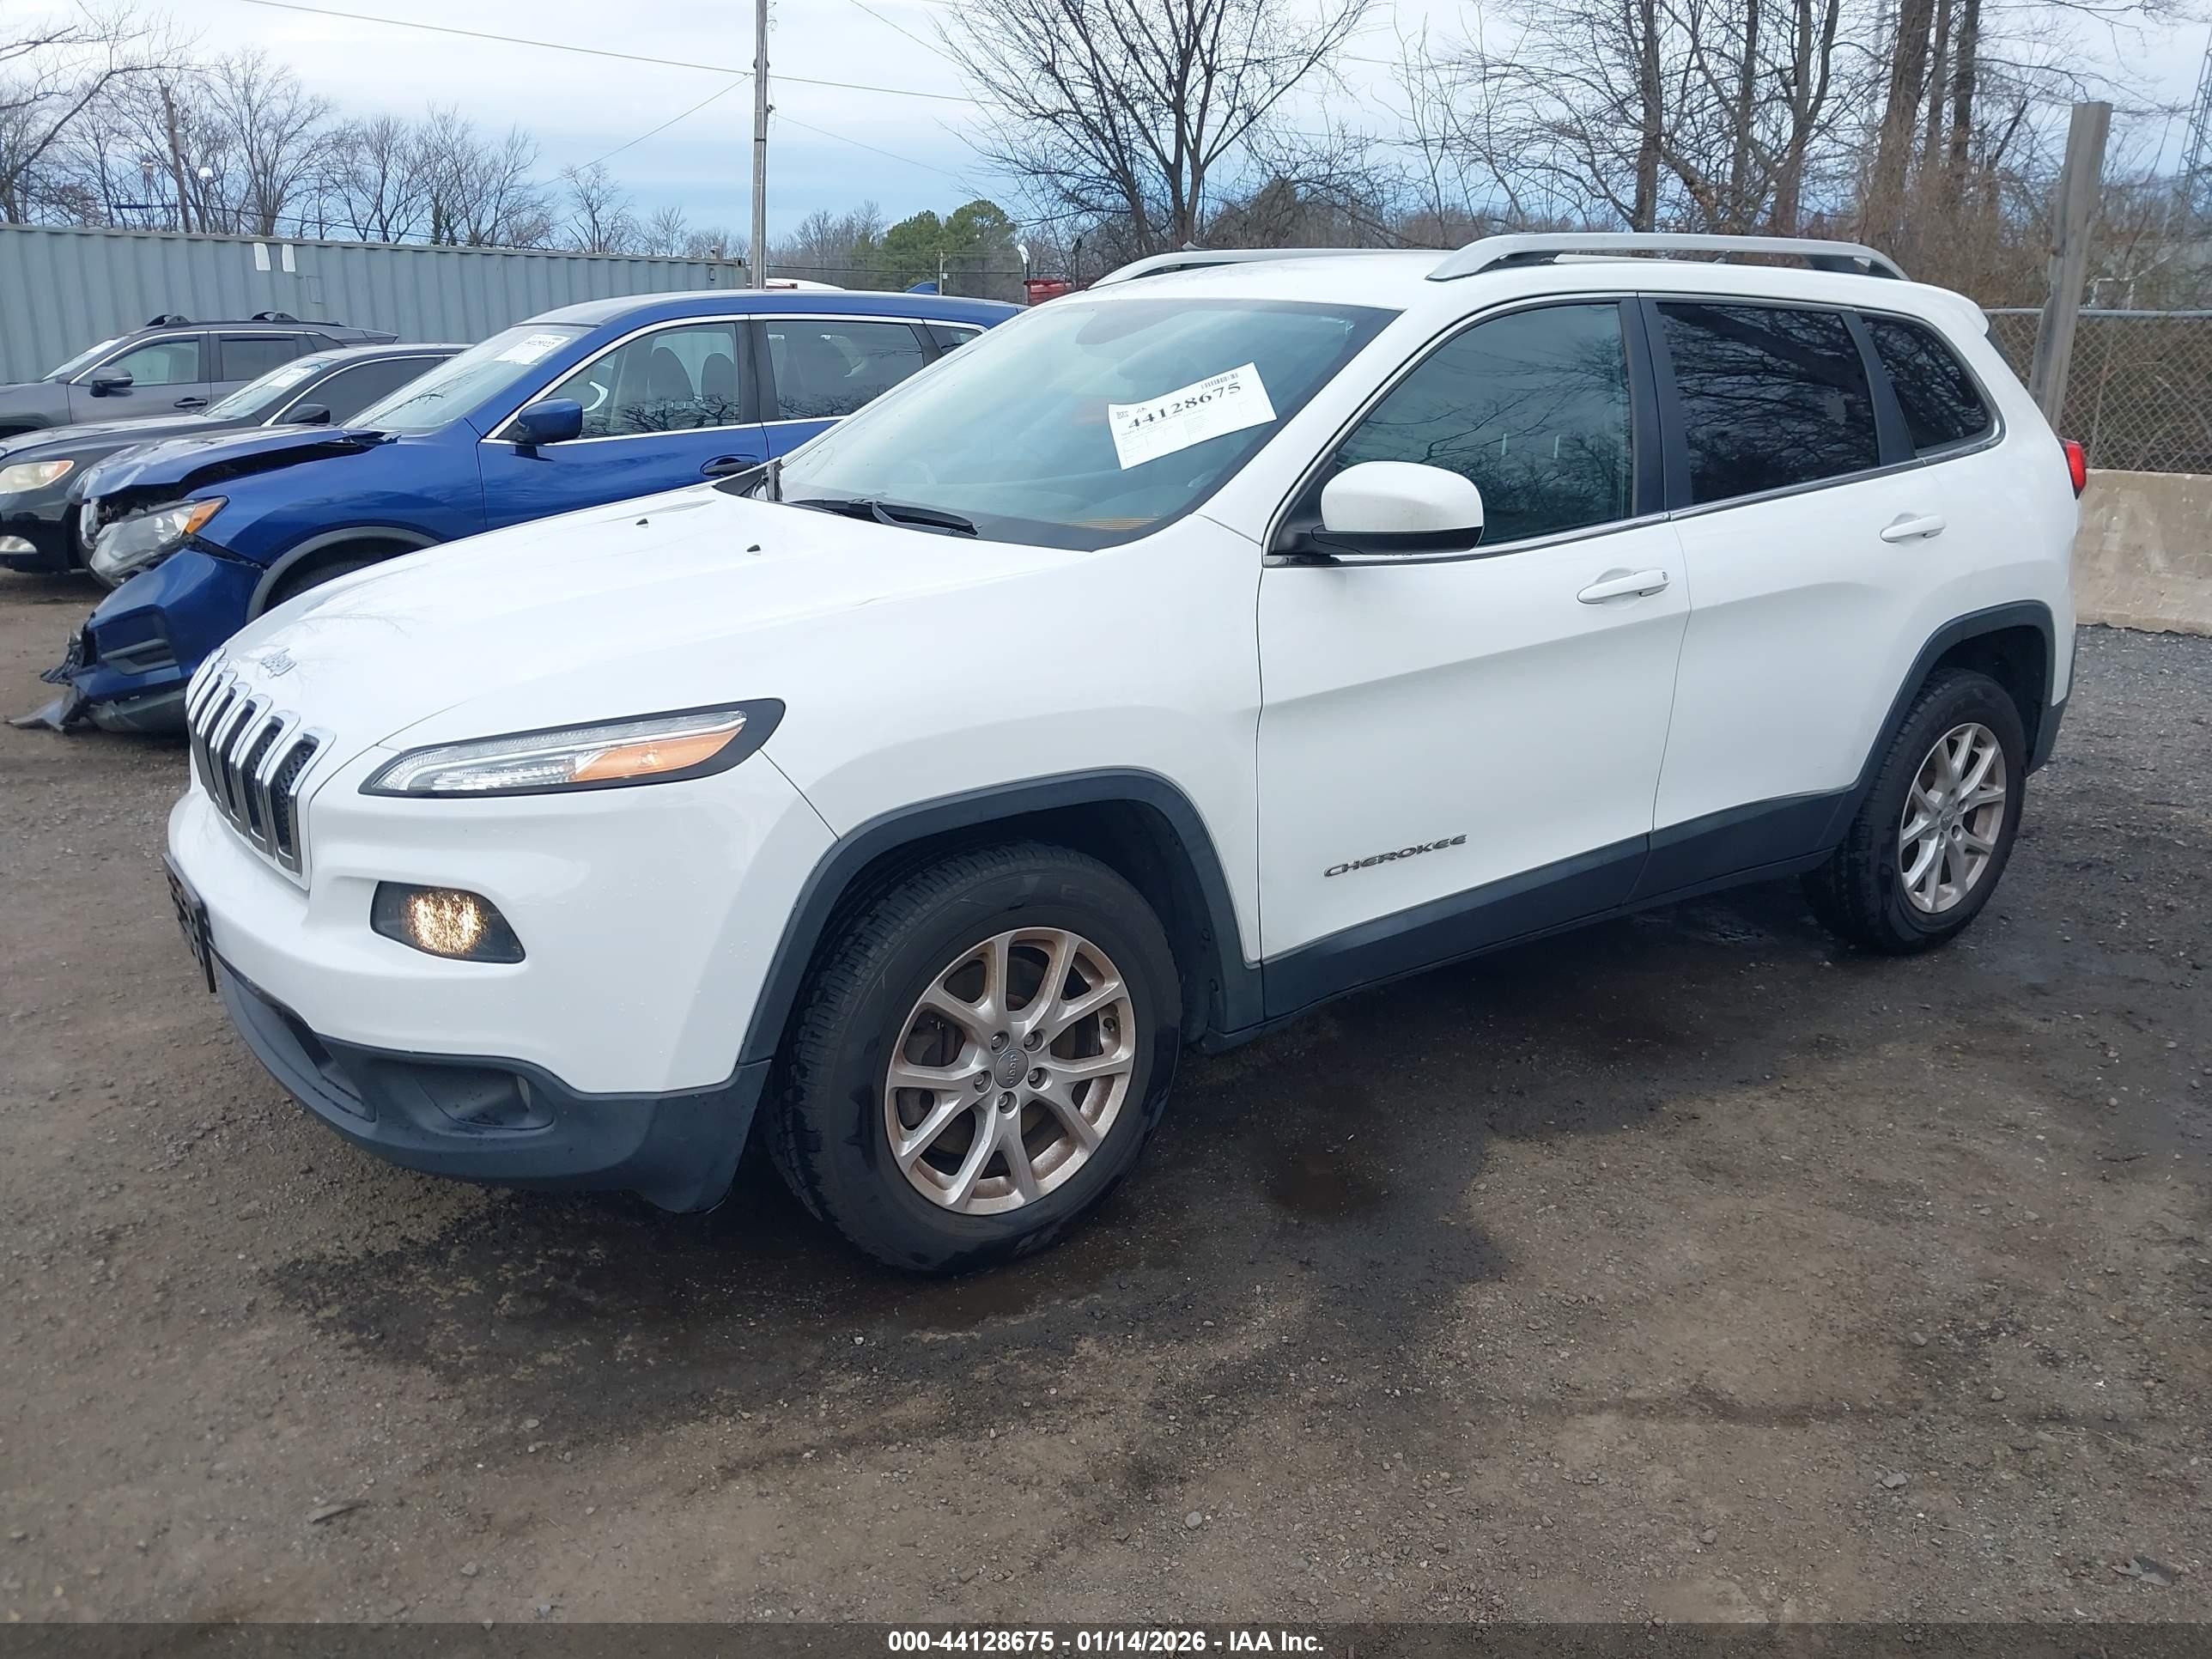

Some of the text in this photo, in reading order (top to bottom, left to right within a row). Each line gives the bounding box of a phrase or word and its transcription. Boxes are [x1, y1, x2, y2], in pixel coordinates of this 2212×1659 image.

[1128, 382, 1242, 428] 44128675
[1324, 835, 1467, 877] CHEROKEE
[1006, 1054, 1019, 1085] Jeep
